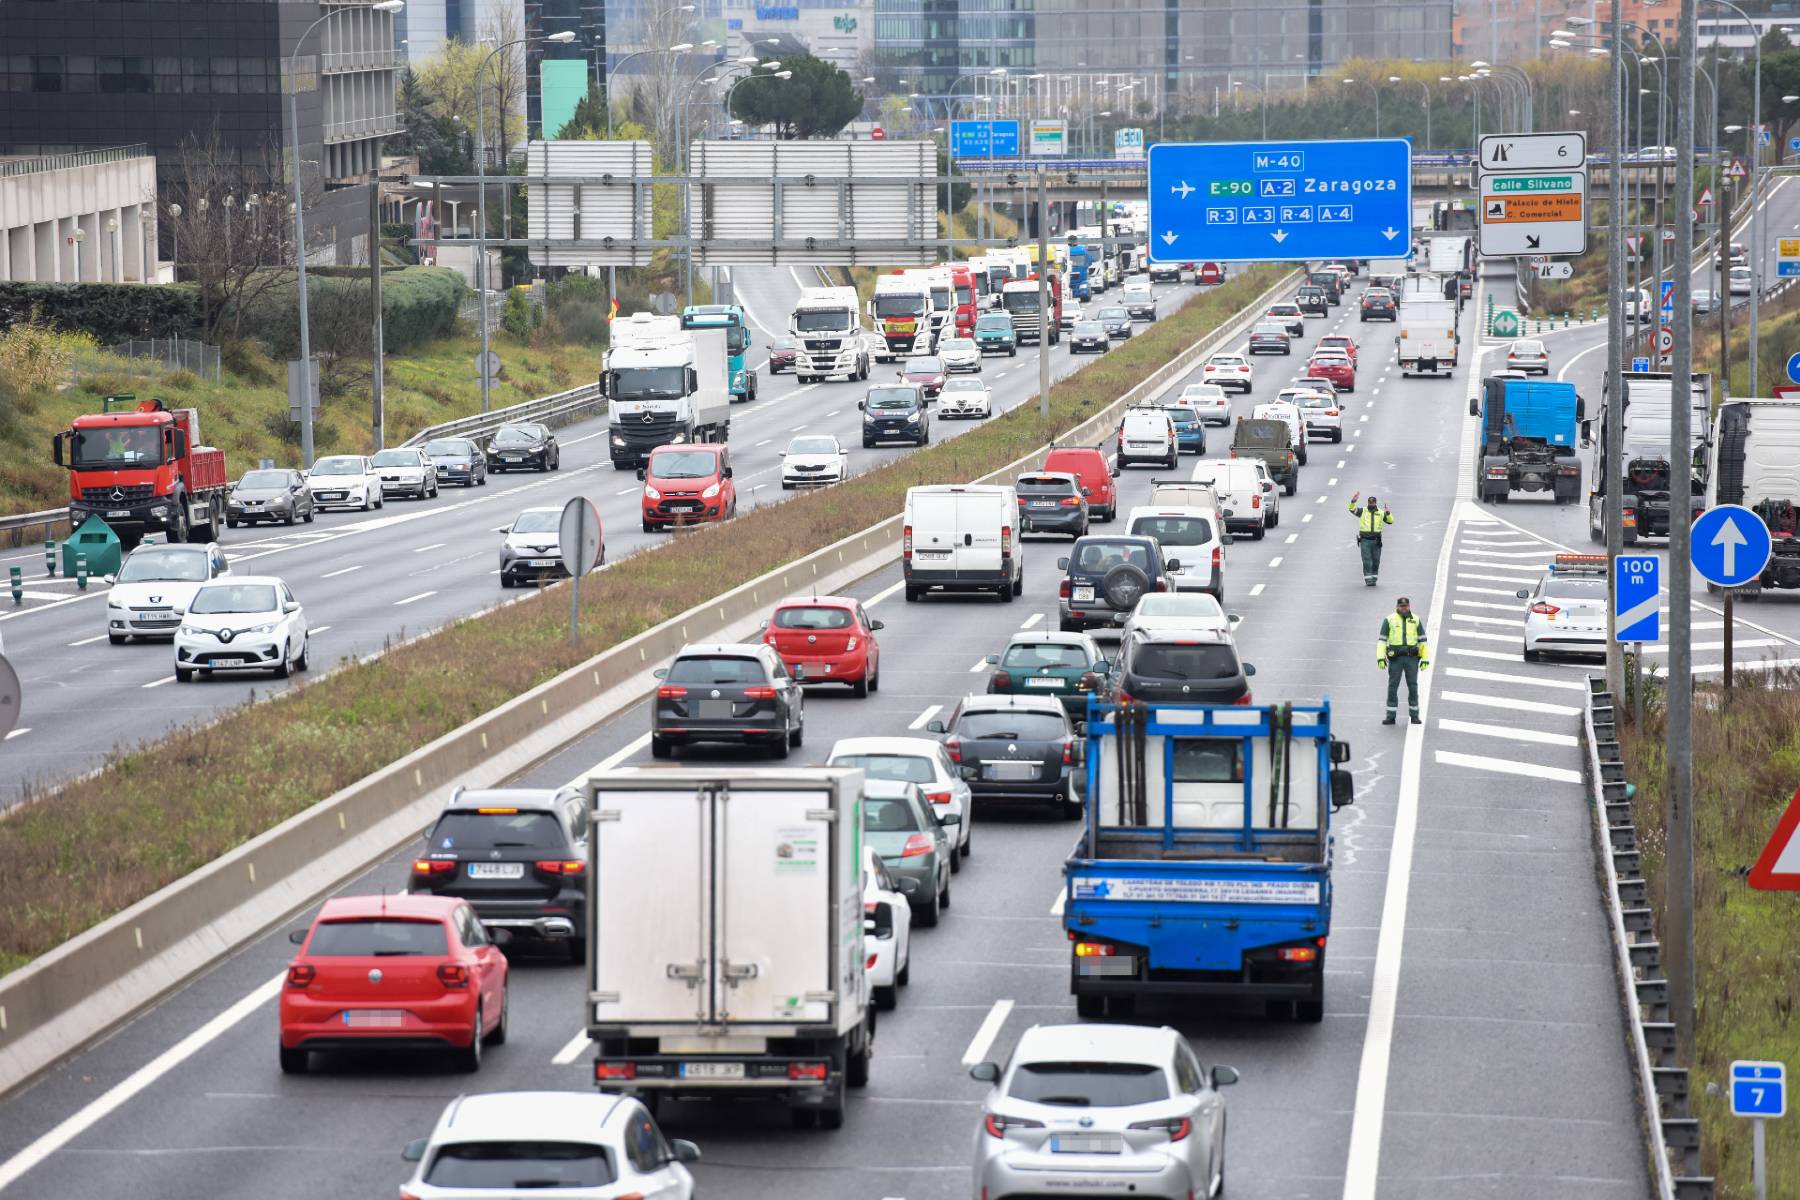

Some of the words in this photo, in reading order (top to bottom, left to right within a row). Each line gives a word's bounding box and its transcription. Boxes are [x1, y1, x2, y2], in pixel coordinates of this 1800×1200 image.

[1558, 145, 1567, 157] 6
[1256, 155, 1301, 168] M-40
[1210, 182, 1252, 194] E-90
[1264, 182, 1293, 194] A-2
[1304, 178, 1396, 195] Zaragoza
[1494, 180, 1522, 190] calle
[1528, 179, 1571, 189] Silvano
[1507, 199, 1539, 207] Palacio
[1209, 210, 1235, 222] R-3
[1246, 209, 1272, 221] A-3
[1282, 209, 1310, 220] R-4
[1321, 207, 1350, 220] A-4
[1520, 210, 1562, 218] Comercial
[1563, 267, 1569, 275] 6
[1622, 560, 1654, 573] 100
[1631, 575, 1644, 584] m
[1751, 1087, 1765, 1107] 7
